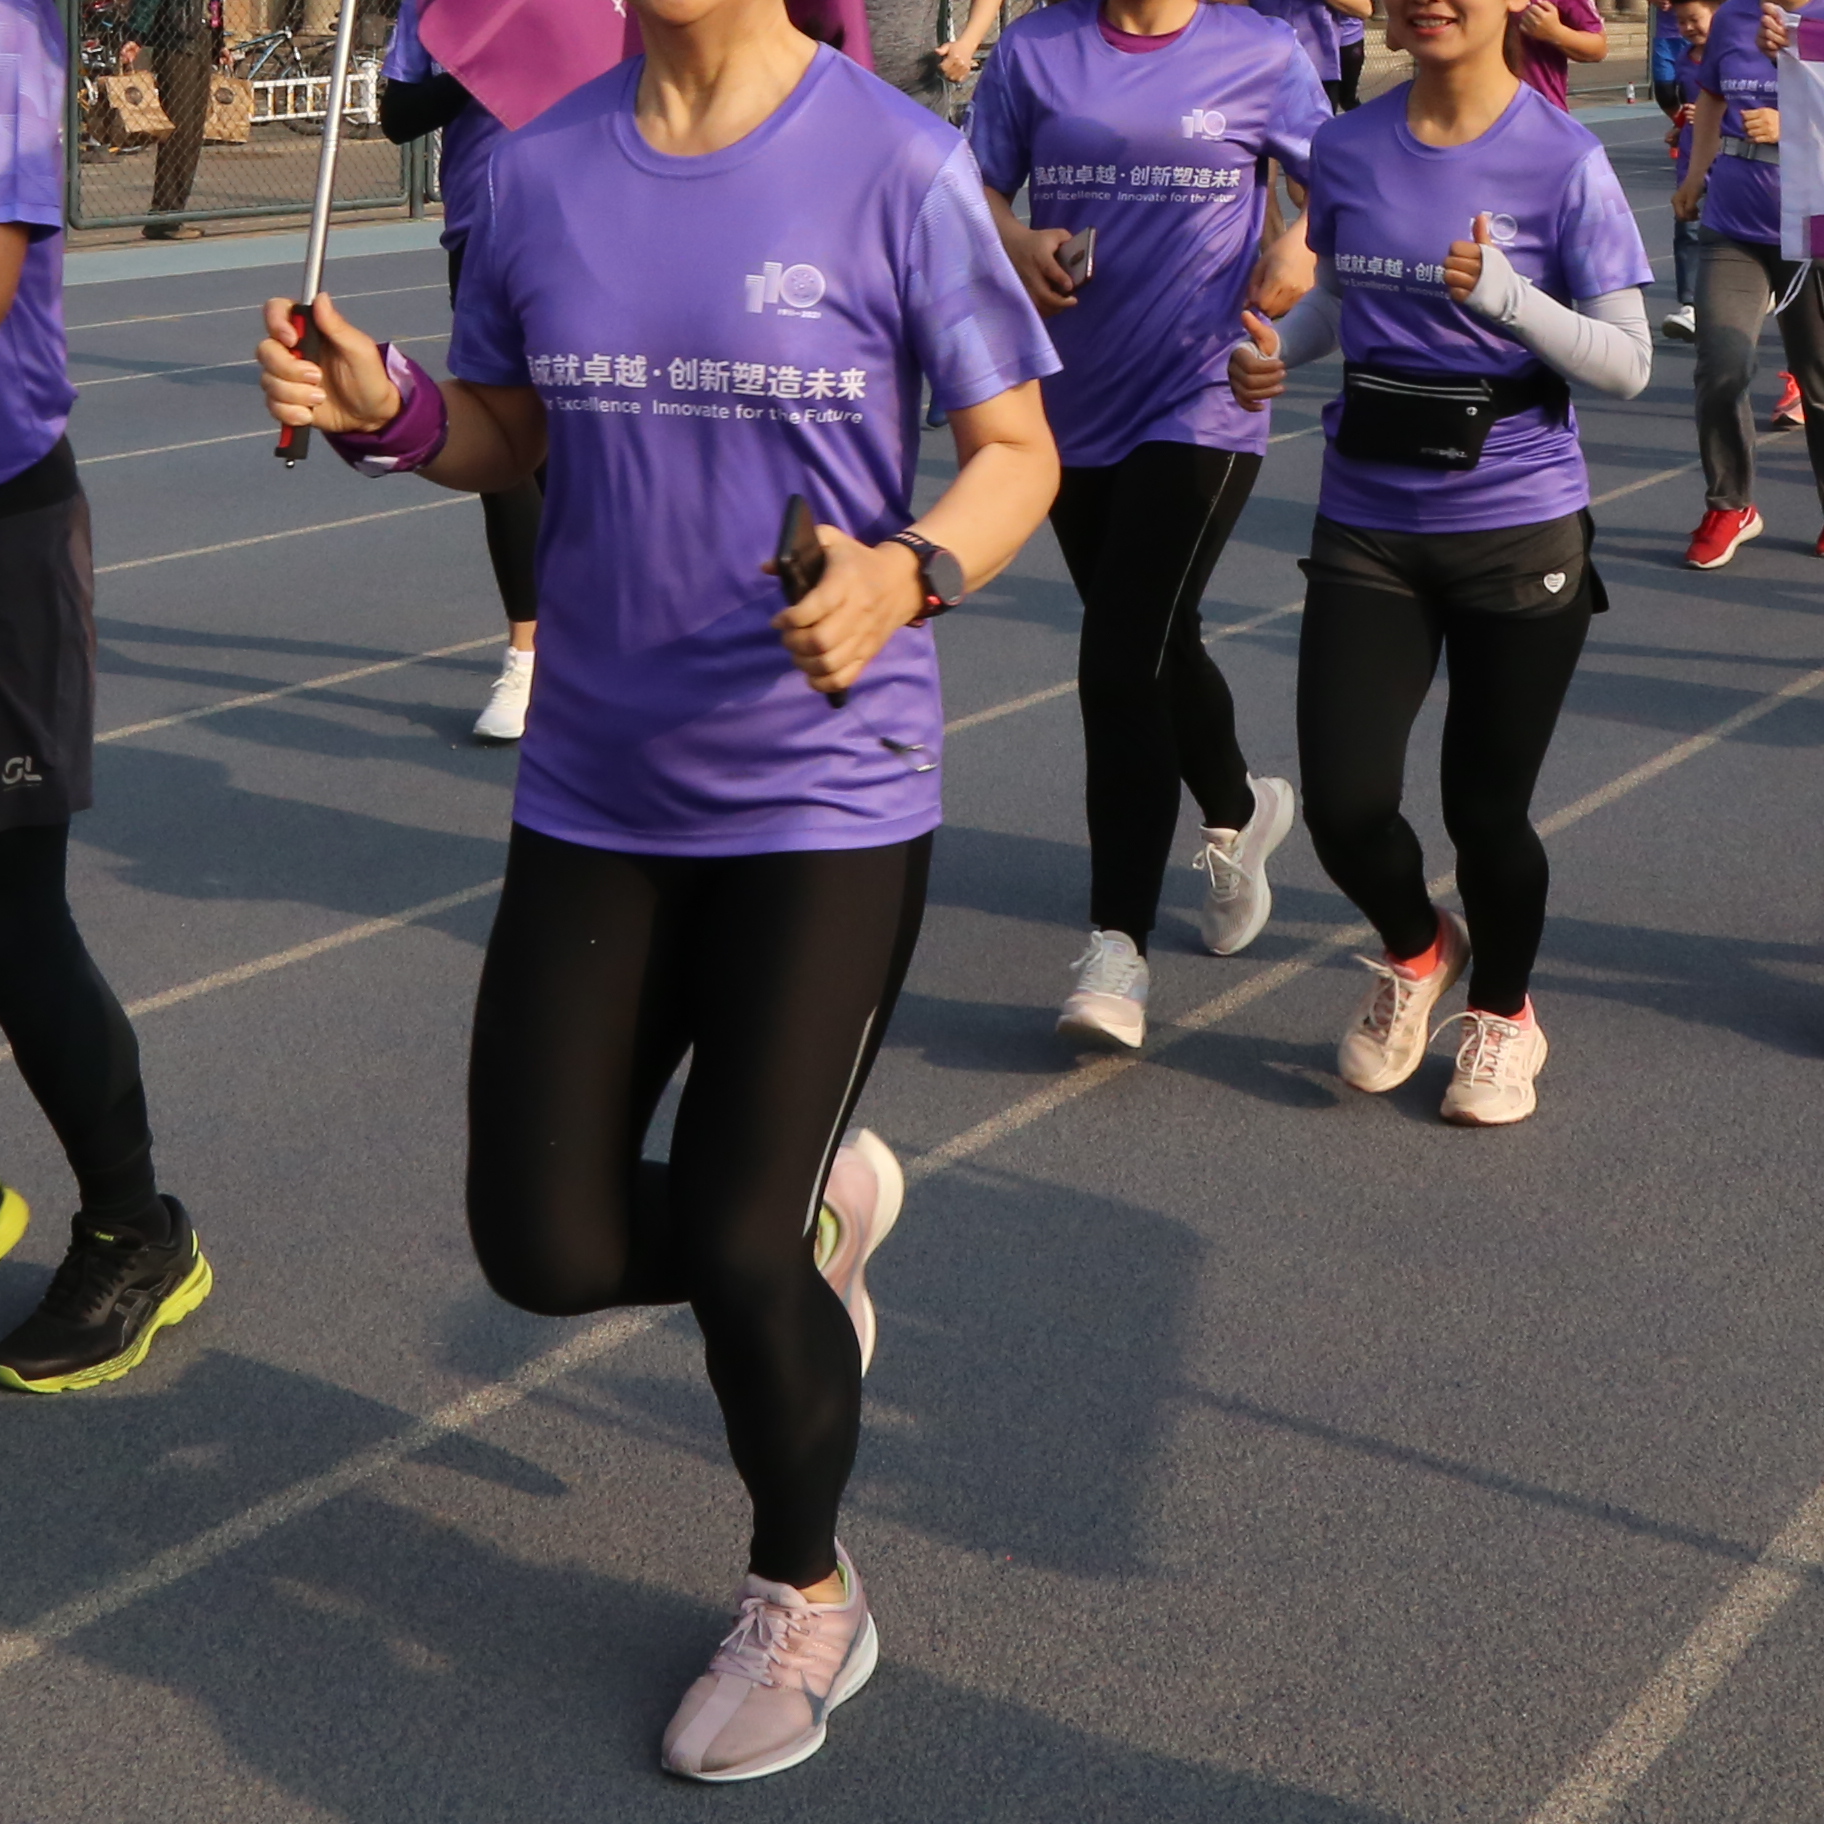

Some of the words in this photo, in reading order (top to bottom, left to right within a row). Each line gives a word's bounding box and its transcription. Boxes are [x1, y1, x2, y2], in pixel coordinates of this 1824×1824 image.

[557, 396, 642, 415] Excellence
[652, 398, 730, 419] Innovate
[735, 403, 764, 420] for
[768, 407, 802, 425] the
[803, 407, 864, 425] Future
